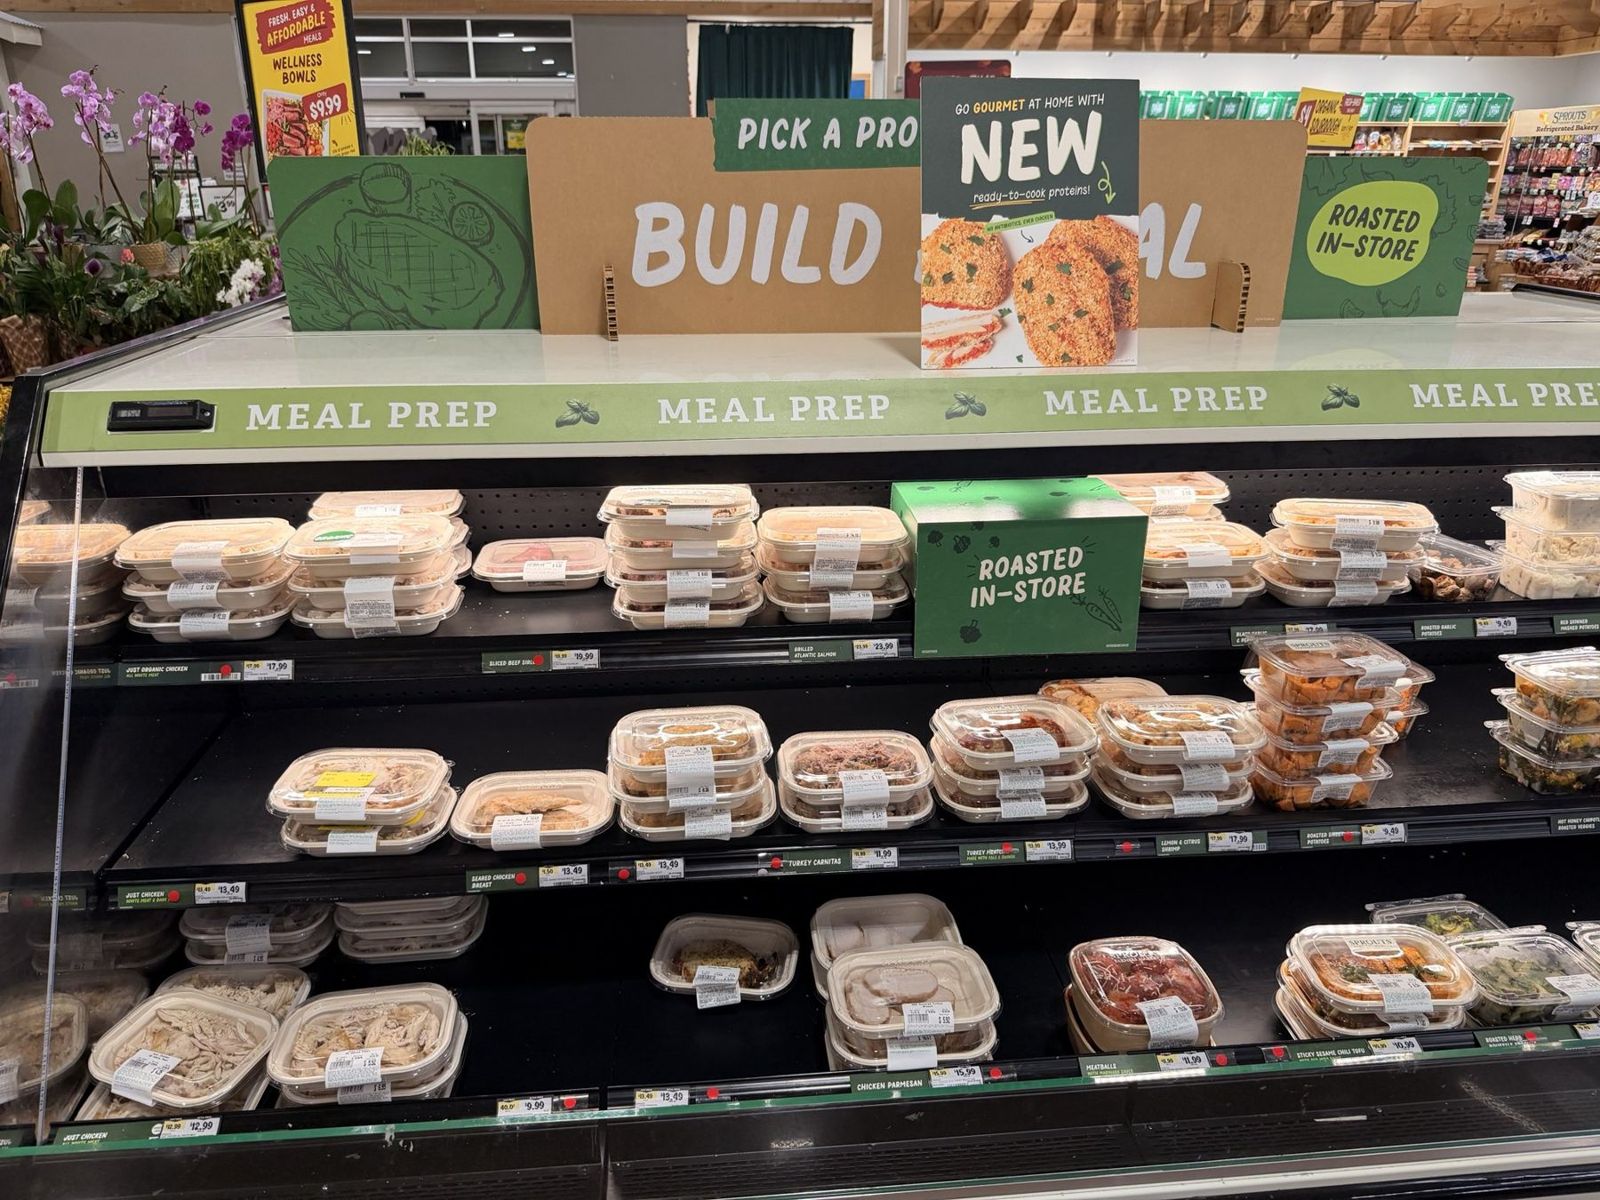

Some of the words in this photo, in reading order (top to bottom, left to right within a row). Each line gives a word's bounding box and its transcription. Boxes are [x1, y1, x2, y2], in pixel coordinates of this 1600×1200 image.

[292, 5, 309, 20] EASY
[267, 11, 326, 47] AFFORDABLE
[303, 32, 322, 44] MEALS
[272, 53, 323, 71] WELLNESS
[282, 70, 316, 85] BOWLS
[309, 94, 342, 121] $9.99
[955, 103, 970, 115] GO
[973, 99, 1025, 114] GOURMET
[1028, 98, 1042, 110] AT
[1045, 97, 1075, 109] HOME
[1078, 93, 1105, 107] WITH
[1552, 110, 1587, 124] SPROUTS
[1536, 124, 1575, 132] Refrigerated
[1575, 124, 1599, 132] Bakery
[737, 117, 811, 151] PICK
[822, 117, 842, 150] A
[960, 110, 1103, 185] NEW
[973, 187, 1046, 205] ready-to-cook
[1048, 184, 1091, 201] proteins!
[1328, 203, 1421, 233] ROASTED
[631, 201, 883, 287] BUILD
[1315, 231, 1420, 262] IN-STORE
[1043, 387, 1159, 416] MEAL
[1168, 385, 1269, 412] PREP
[1408, 383, 1519, 408] MEAL
[1526, 382, 1600, 407] PRE
[657, 396, 775, 424] MEAL
[788, 394, 890, 421] PREP
[246, 401, 372, 431] MEAL
[387, 400, 498, 428] PREP
[978, 546, 1084, 581] ROASTED
[970, 572, 1086, 608] IN-STORE
[1495, 620, 1512, 628] $9.49
[873, 642, 894, 650] $23.99
[574, 652, 594, 660] $19.99
[267, 662, 288, 672] $17.99
[1383, 827, 1399, 835] $9.49
[1229, 835, 1248, 843] $17.99
[1047, 841, 1067, 850] $13.99
[875, 849, 892, 858] $11.99
[658, 860, 679, 869] $13.49
[788, 859, 812, 867] TURKEY
[813, 858, 842, 866] CARNITAS
[562, 866, 583, 875] $13.49
[218, 885, 240, 894] $13.49
[1485, 1035, 1508, 1043] ROASTED
[1393, 1041, 1415, 1049] $10.99
[1182, 1056, 1202, 1065] $11.99
[1296, 1051, 1315, 1059] STICKY
[954, 1067, 976, 1076] $15.99
[857, 1082, 885, 1091] CHICKEN
[887, 1079, 923, 1089] PARMESAN
[660, 1091, 684, 1102] $13.49
[524, 1101, 545, 1111] $9.99
[190, 1121, 213, 1132] $12.99
[63, 1133, 80, 1142] JUST
[80, 1131, 109, 1140] CHICKEN
